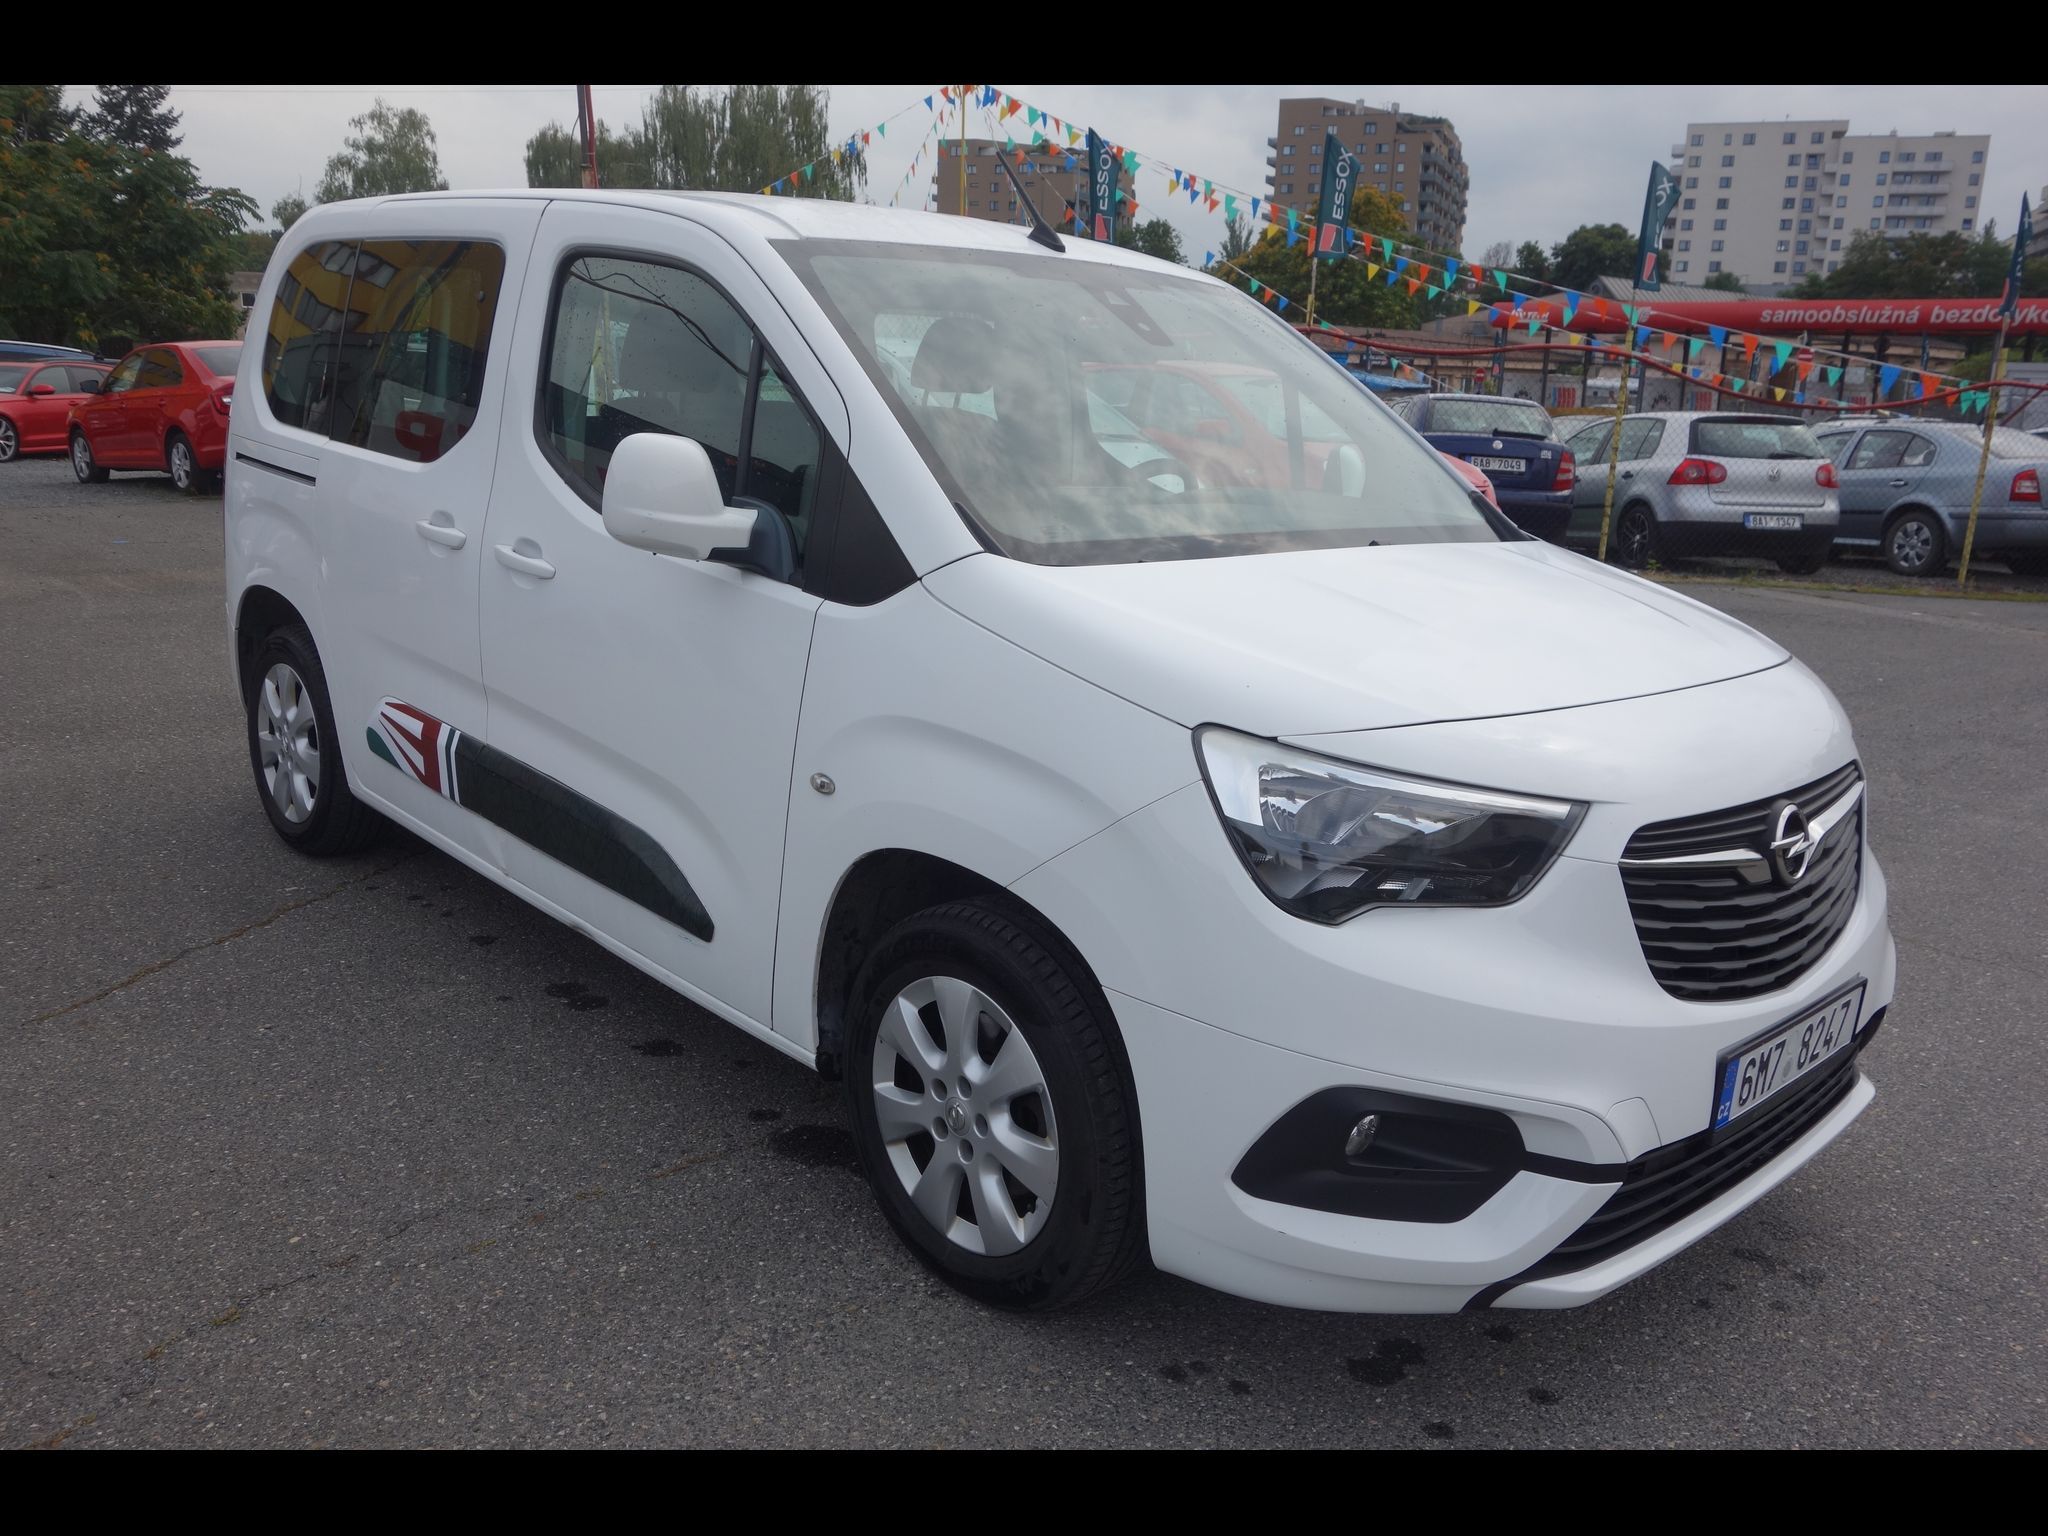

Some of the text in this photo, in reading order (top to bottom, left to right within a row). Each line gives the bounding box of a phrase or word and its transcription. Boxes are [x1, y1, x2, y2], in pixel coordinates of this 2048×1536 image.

[1332, 147, 1353, 221] ESSOX
[1760, 305, 1921, 325] samoobslužná
[1473, 458, 1521, 470] 6A8 7049
[1738, 998, 1852, 1106] 6M7 8247
[1717, 1101, 1731, 1120] CZ
